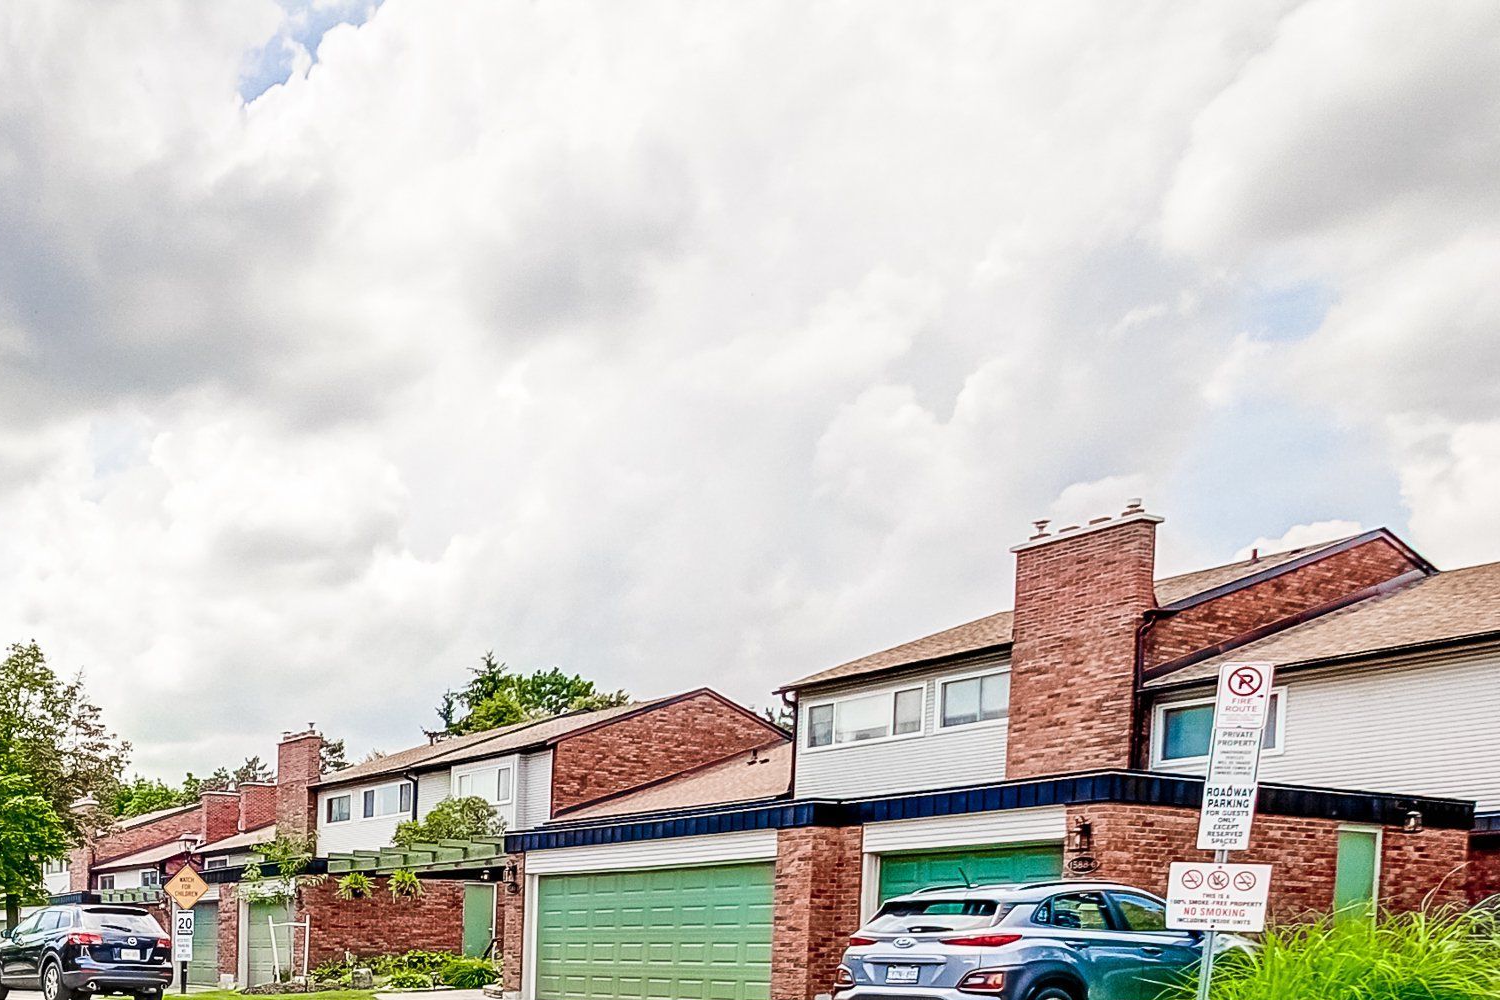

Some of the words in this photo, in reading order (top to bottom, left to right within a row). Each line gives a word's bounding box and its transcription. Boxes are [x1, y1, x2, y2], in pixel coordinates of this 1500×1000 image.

[1206, 787, 1254, 797] ROADWAY
[1207, 799, 1250, 808] PARKING
[1183, 907, 1197, 915] NO
[1200, 907, 1246, 917] SMOKING
[178, 917, 192, 930] 20
